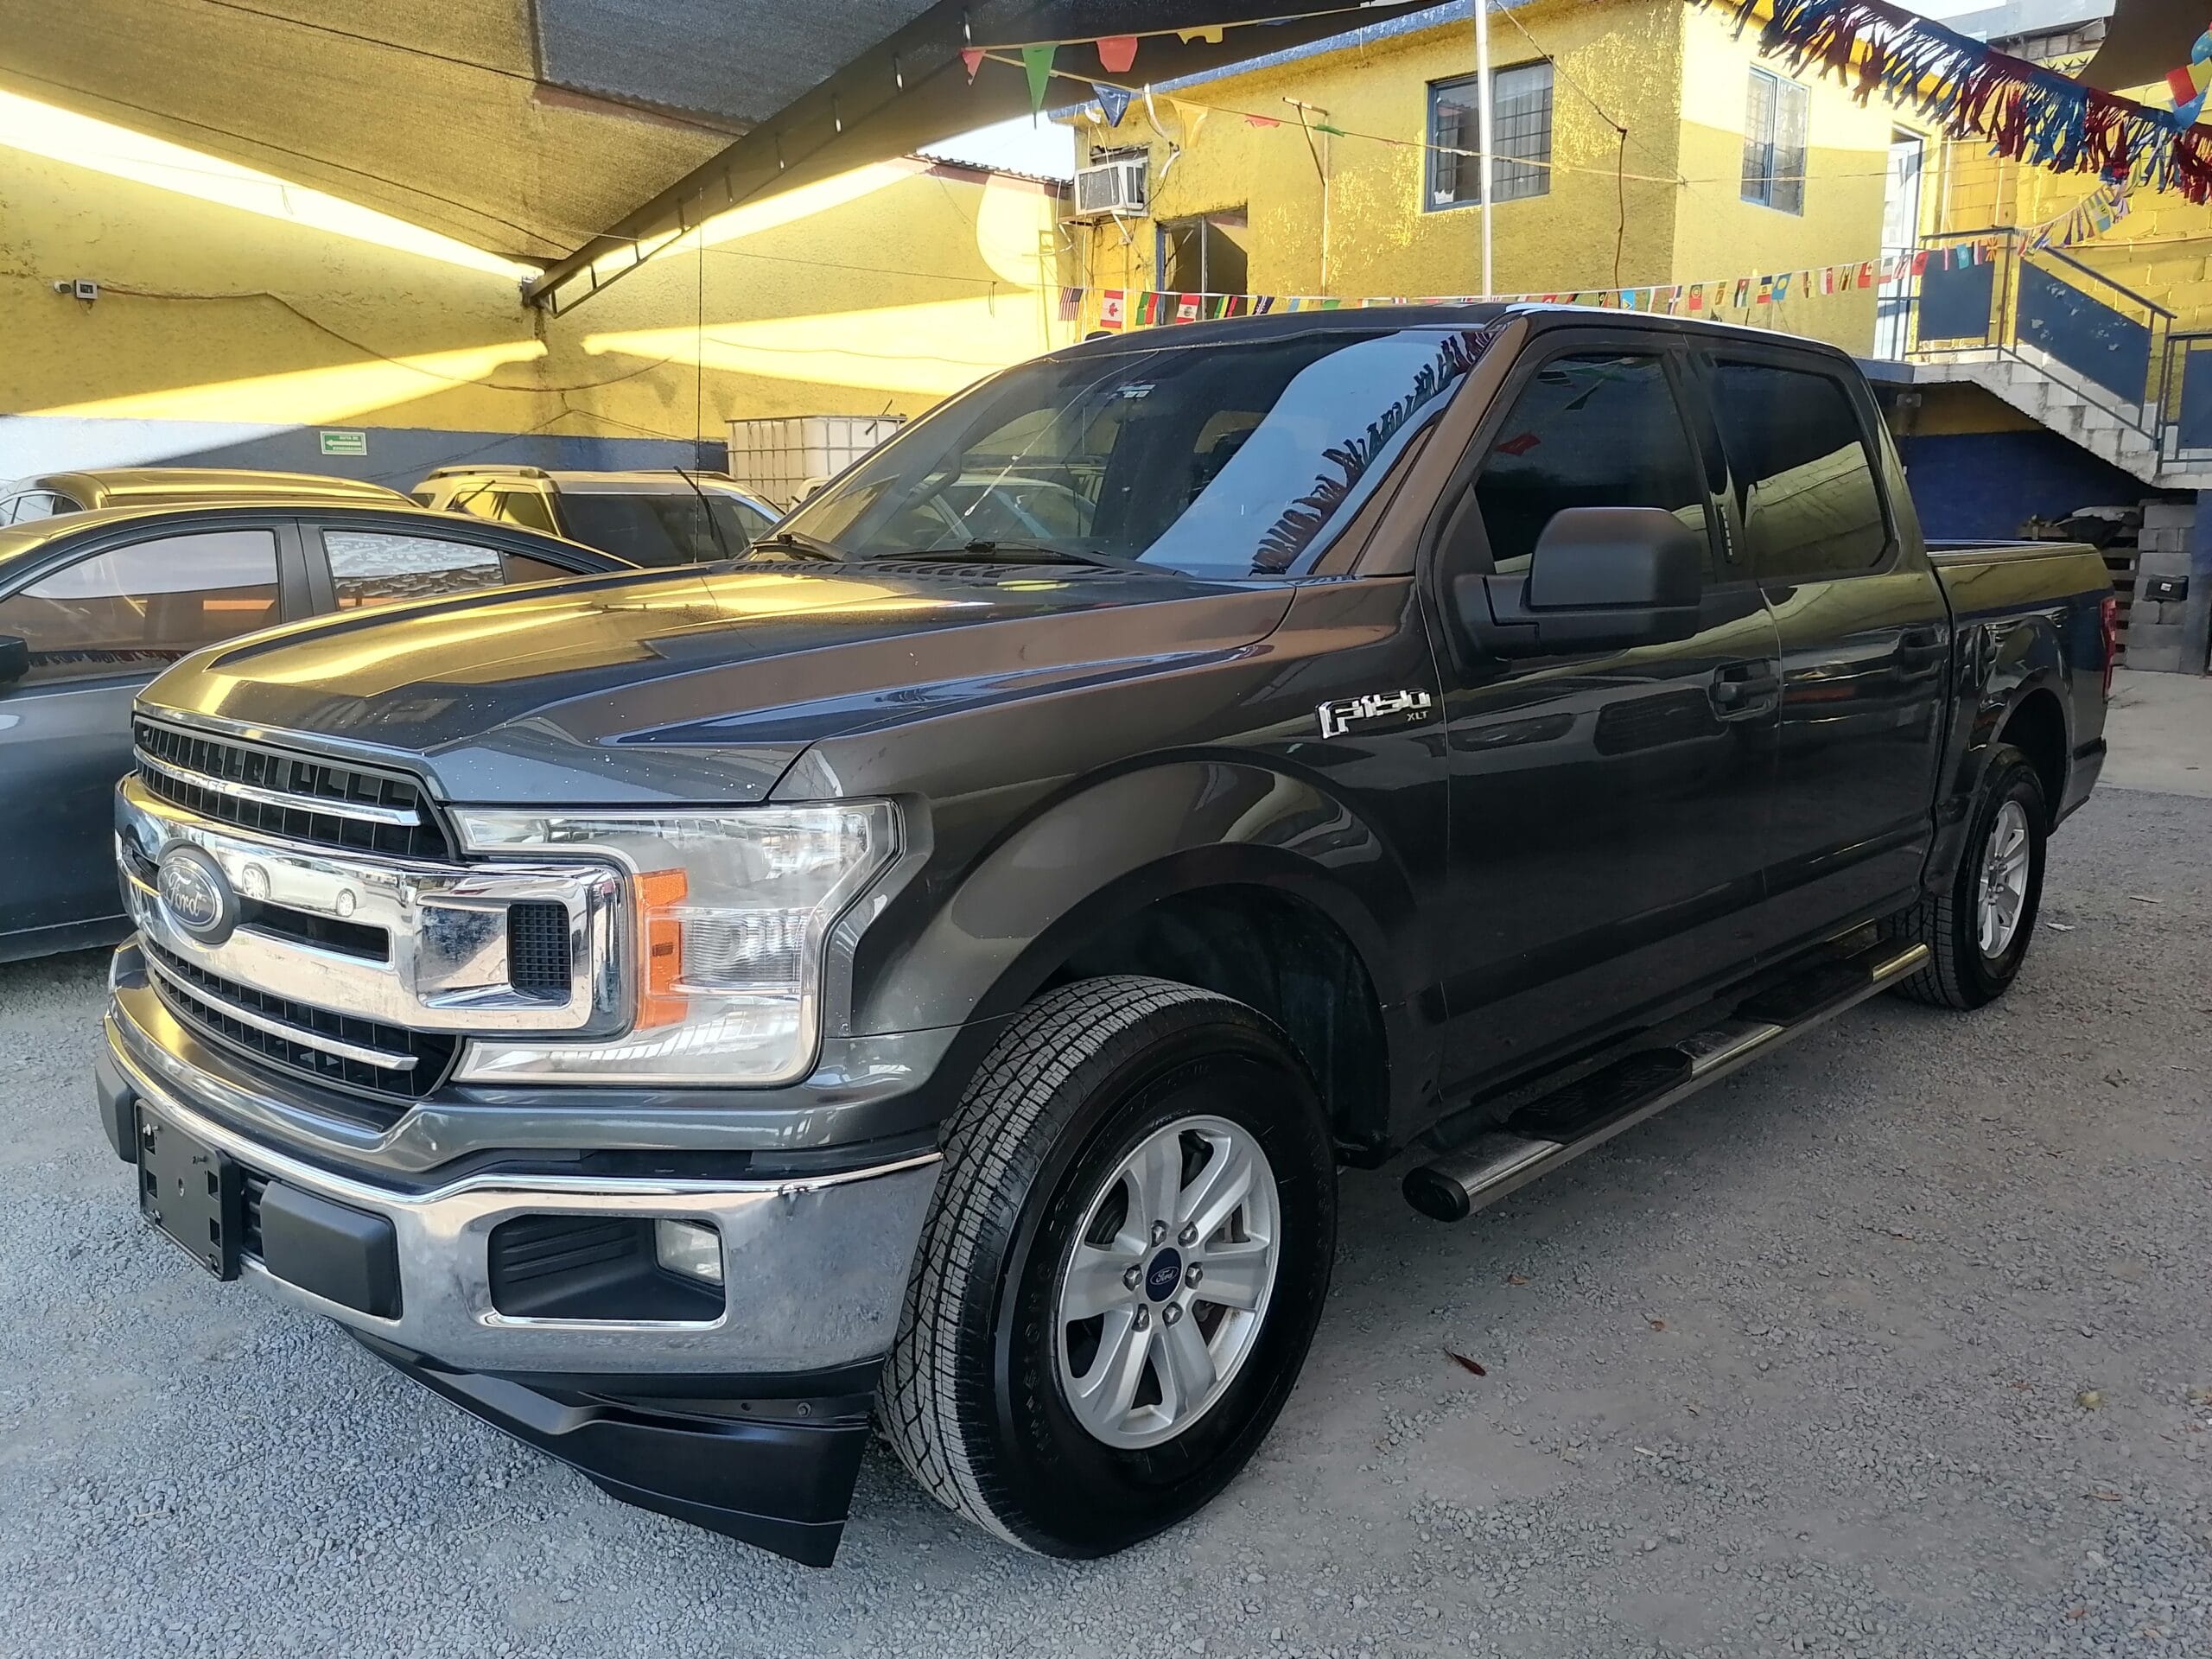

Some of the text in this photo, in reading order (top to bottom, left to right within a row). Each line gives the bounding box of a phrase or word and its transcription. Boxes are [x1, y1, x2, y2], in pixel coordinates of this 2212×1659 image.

[1407, 710, 1428, 721] XLT
[166, 871, 200, 917] Ford
[1155, 1269, 1175, 1283] Ford
